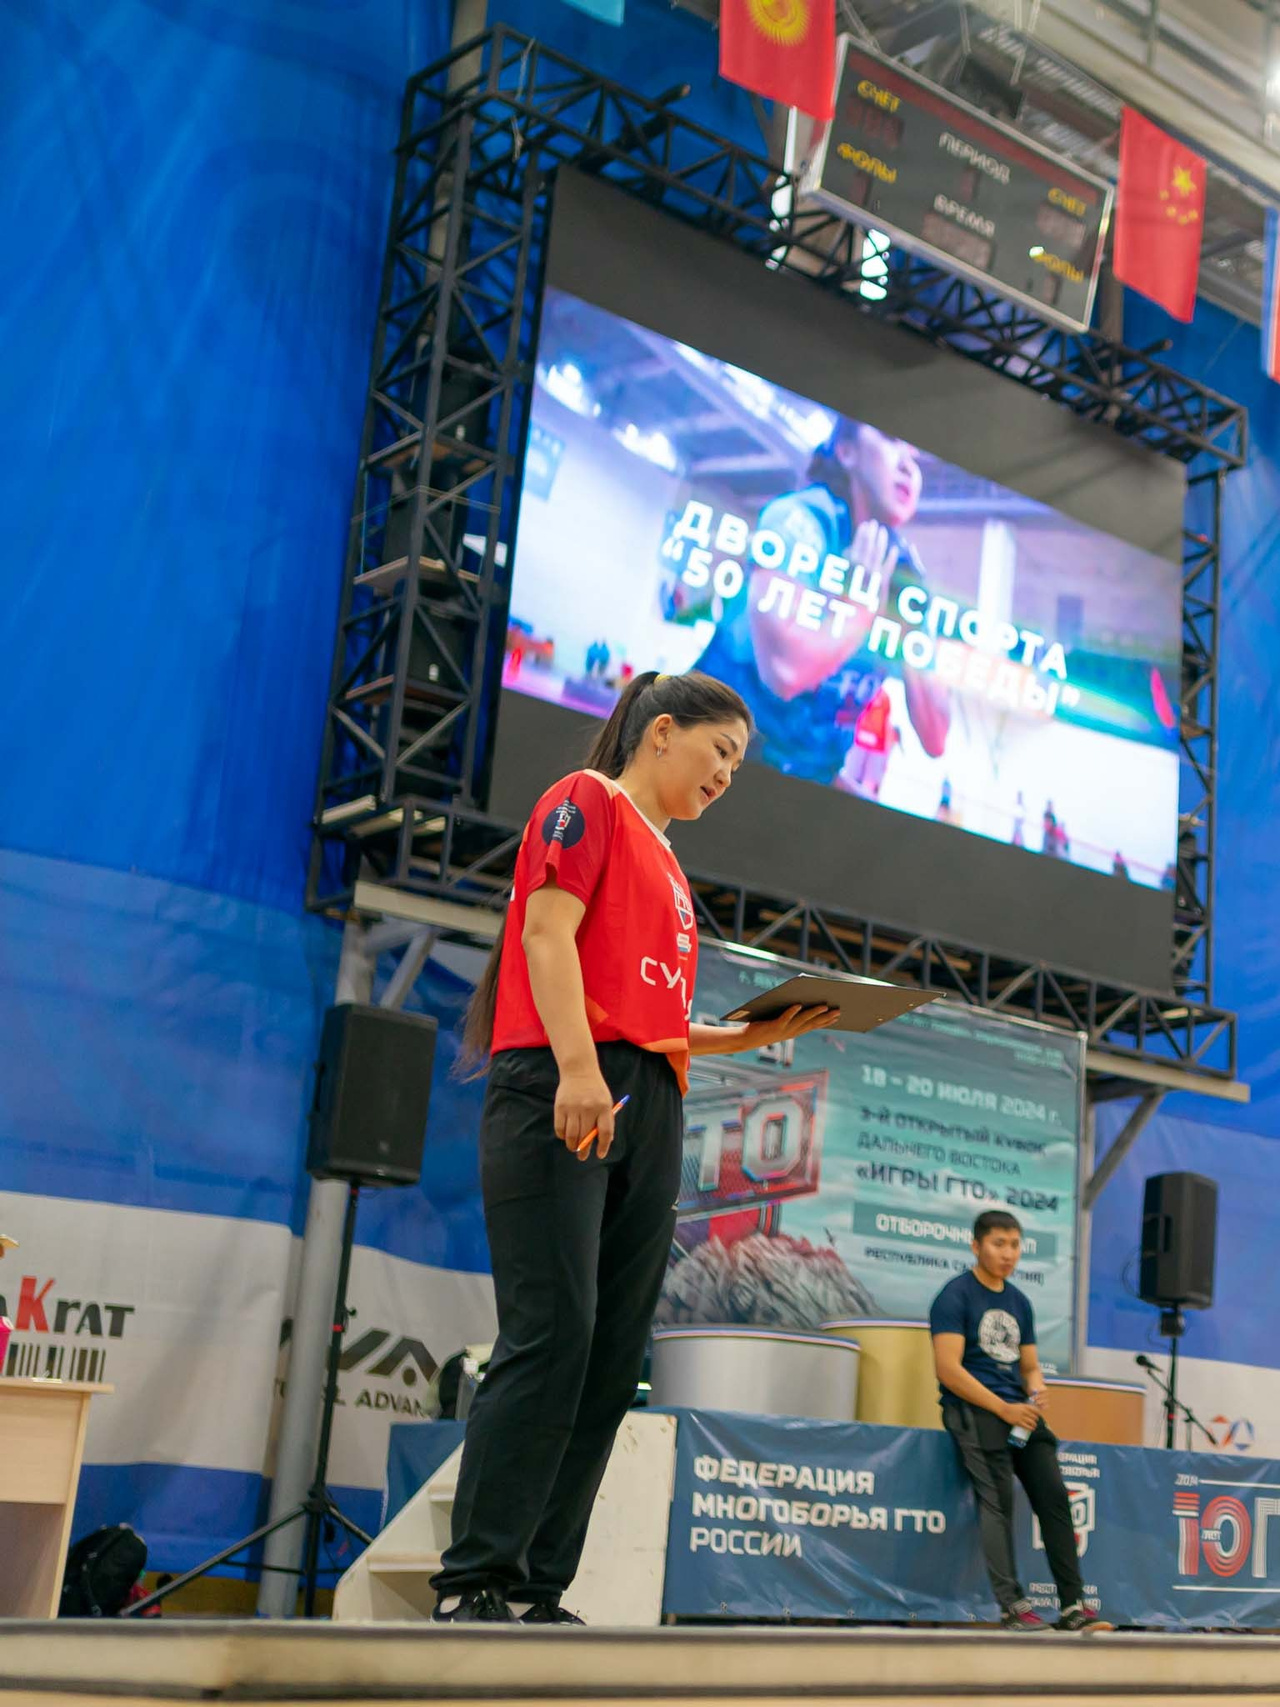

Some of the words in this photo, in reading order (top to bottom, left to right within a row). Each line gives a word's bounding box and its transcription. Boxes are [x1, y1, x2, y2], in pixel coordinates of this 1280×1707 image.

[837, 142, 898, 184] ФОЛЫ
[939, 132, 1010, 184] ПЕРИОД
[933, 193, 996, 238] ВРЕМЯ
[671, 500, 883, 612] ДВОРЕЦ
[897, 584, 1068, 681] СПОРТА
[757, 576, 857, 640] ЛЕТ
[860, 1064, 887, 1087] 18
[906, 1074, 934, 1098] 20
[936, 1081, 998, 1111] ИЮЛЯ
[1000, 1095, 1046, 1121] 2024
[895, 1112, 991, 1144] ОТКРЫТЫЙ
[857, 1131, 947, 1164] ДАЛЬНЕГО
[951, 1149, 1021, 1177] ВОСТОКА
[856, 1161, 938, 1192] «ИГРЫ
[945, 1176, 999, 1203] ГТО»
[1005, 1185, 1059, 1212] 2024
[875, 1213, 975, 1245] ОТБОРОЧН
[693, 1454, 876, 1497] ФЕДЕРАЦИЯ
[691, 1490, 888, 1532] МНОГОБОРЬЯ
[893, 1508, 947, 1534] ГТО
[689, 1526, 803, 1559] РОССИИ
